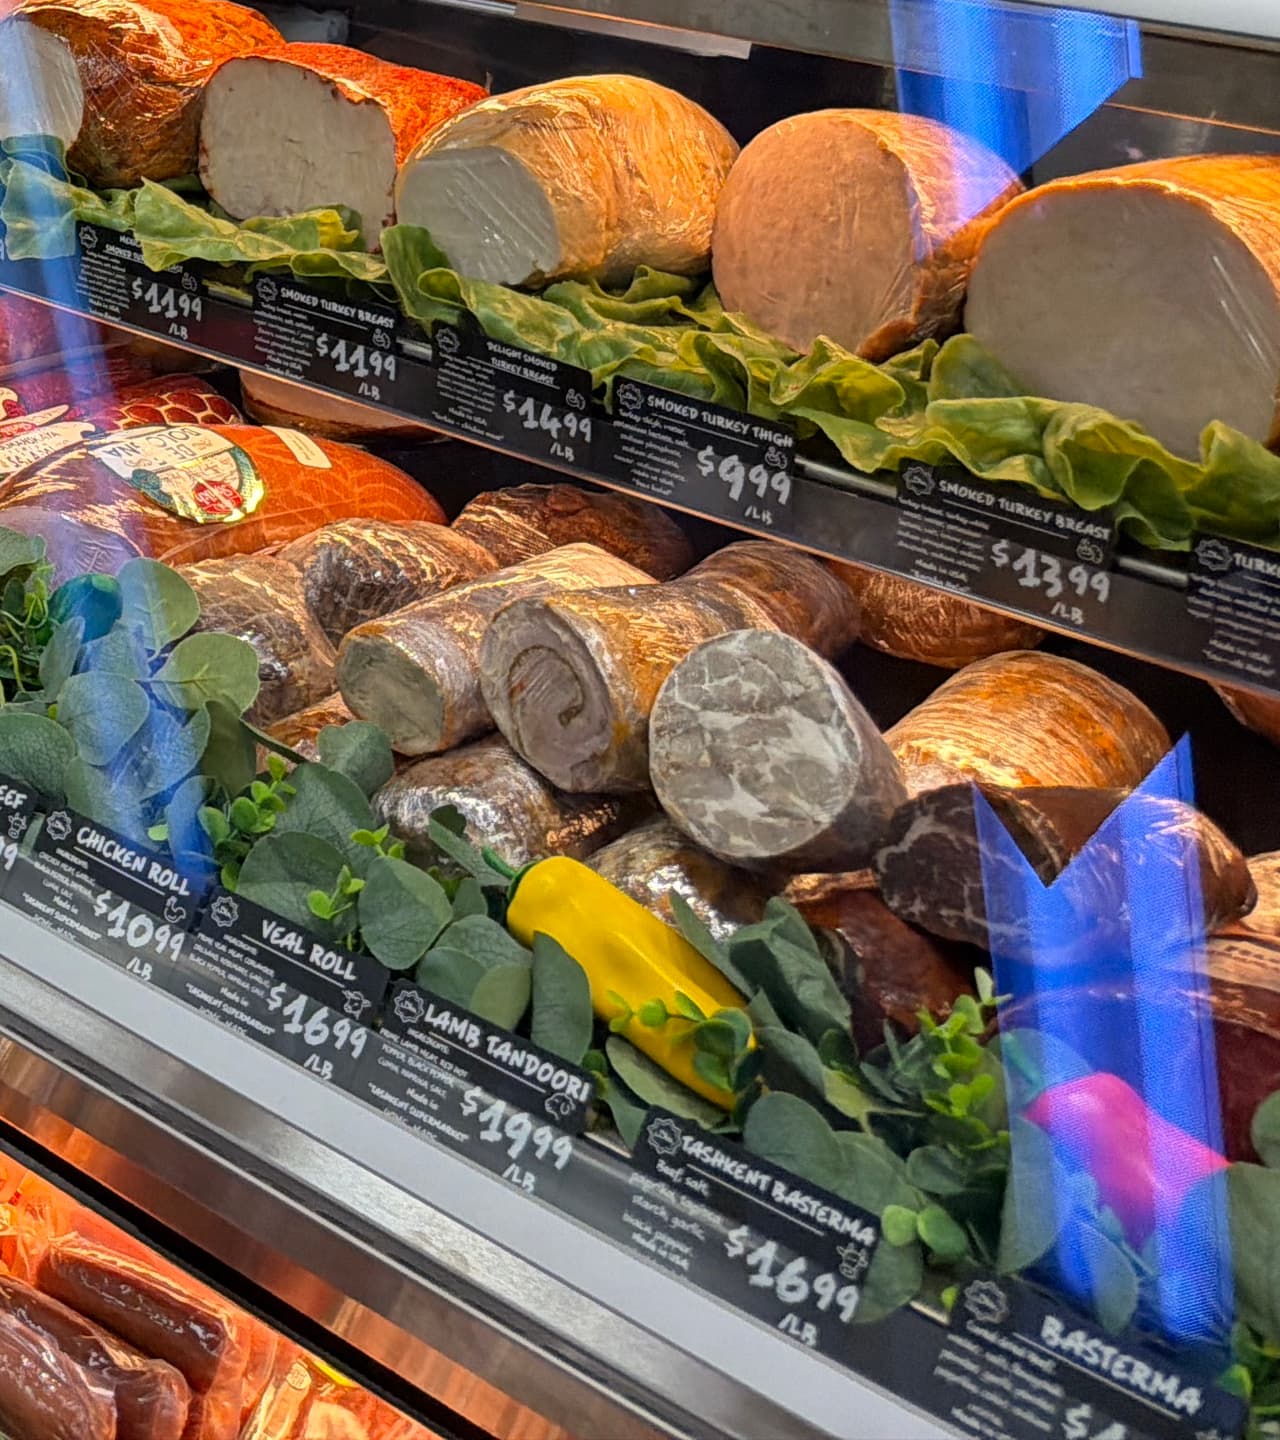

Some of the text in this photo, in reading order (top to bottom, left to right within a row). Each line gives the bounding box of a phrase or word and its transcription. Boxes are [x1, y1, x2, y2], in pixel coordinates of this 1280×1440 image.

[132, 277, 203, 321] $1199
[280, 287, 395, 328] SMOKED TURKEY BREAST
[169, 323, 188, 340] /LB
[315, 332, 396, 381] $1199
[486, 341, 558, 371] DELIGHT SMOKED
[491, 357, 554, 385] TURKEY BREAST
[358, 381, 380, 400] /LB
[502, 390, 592, 442] $1499
[647, 395, 793, 447] SMOKED TURKEY THIGH
[550, 442, 575, 462] /LB
[696, 445, 791, 505] $999
[745, 506, 773, 525] /LB
[939, 481, 1111, 541] SMOKED TURKEY BREAST
[990, 539, 1110, 603] $1399
[1051, 602, 1084, 624] /LB
[76, 827, 190, 896] CHICKEN ROLL
[92, 890, 186, 962] $1099
[126, 956, 153, 981] /LB
[262, 919, 357, 981] VEAL ROLL
[266, 982, 368, 1059] $1699
[304, 1054, 333, 1080] /LB
[424, 1003, 591, 1103] LAMB TANDOORI
[406, 1088, 428, 1104] Made
[459, 1085, 573, 1171] $1999
[502, 1163, 536, 1194] /LB
[656, 1159, 684, 1183] Beef,
[681, 1135, 876, 1246] TASHKENT BASTERMA
[724, 1224, 859, 1323] $1699
[778, 1312, 817, 1347] /LB
[1041, 1315, 1202, 1414] BASTERMA
